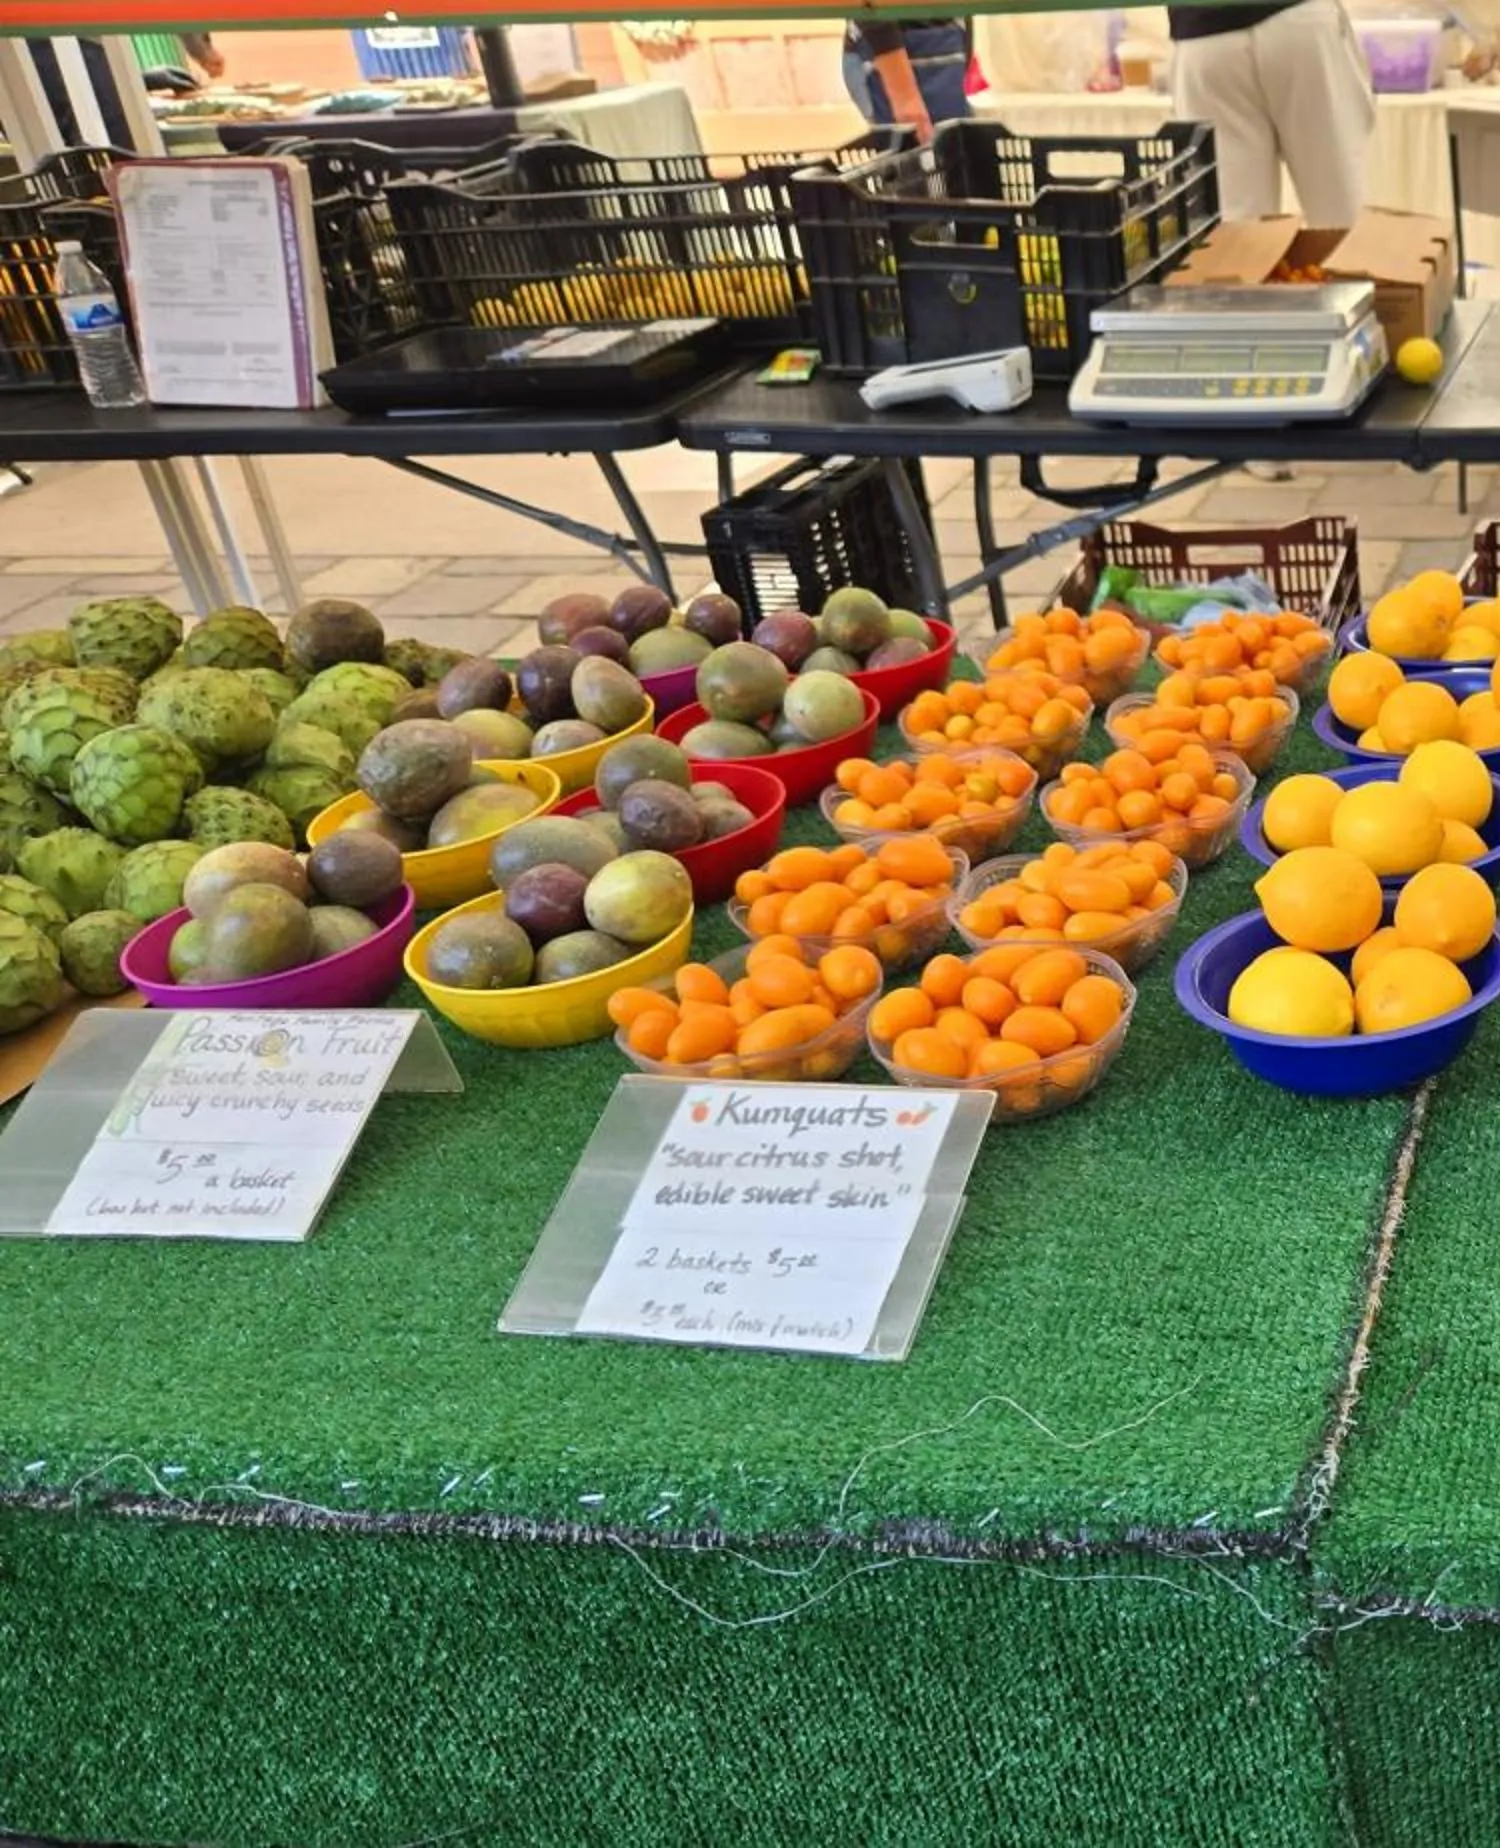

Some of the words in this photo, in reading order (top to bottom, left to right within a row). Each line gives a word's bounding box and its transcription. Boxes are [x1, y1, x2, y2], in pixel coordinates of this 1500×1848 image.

[173, 1017, 305, 1057] Passion
[322, 1025, 401, 1054] Fruit
[317, 1066, 371, 1086] and
[209, 1090, 296, 1120] crunchy
[715, 1090, 888, 1137] Kumquats
[734, 1143, 829, 1168] citrus
[837, 1141, 904, 1173] shot,
[228, 1167, 296, 1189] basket
[654, 1180, 735, 1206] edible
[741, 1179, 821, 1206] sweet
[636, 1247, 659, 1268] 2
[666, 1248, 752, 1275] baskets
